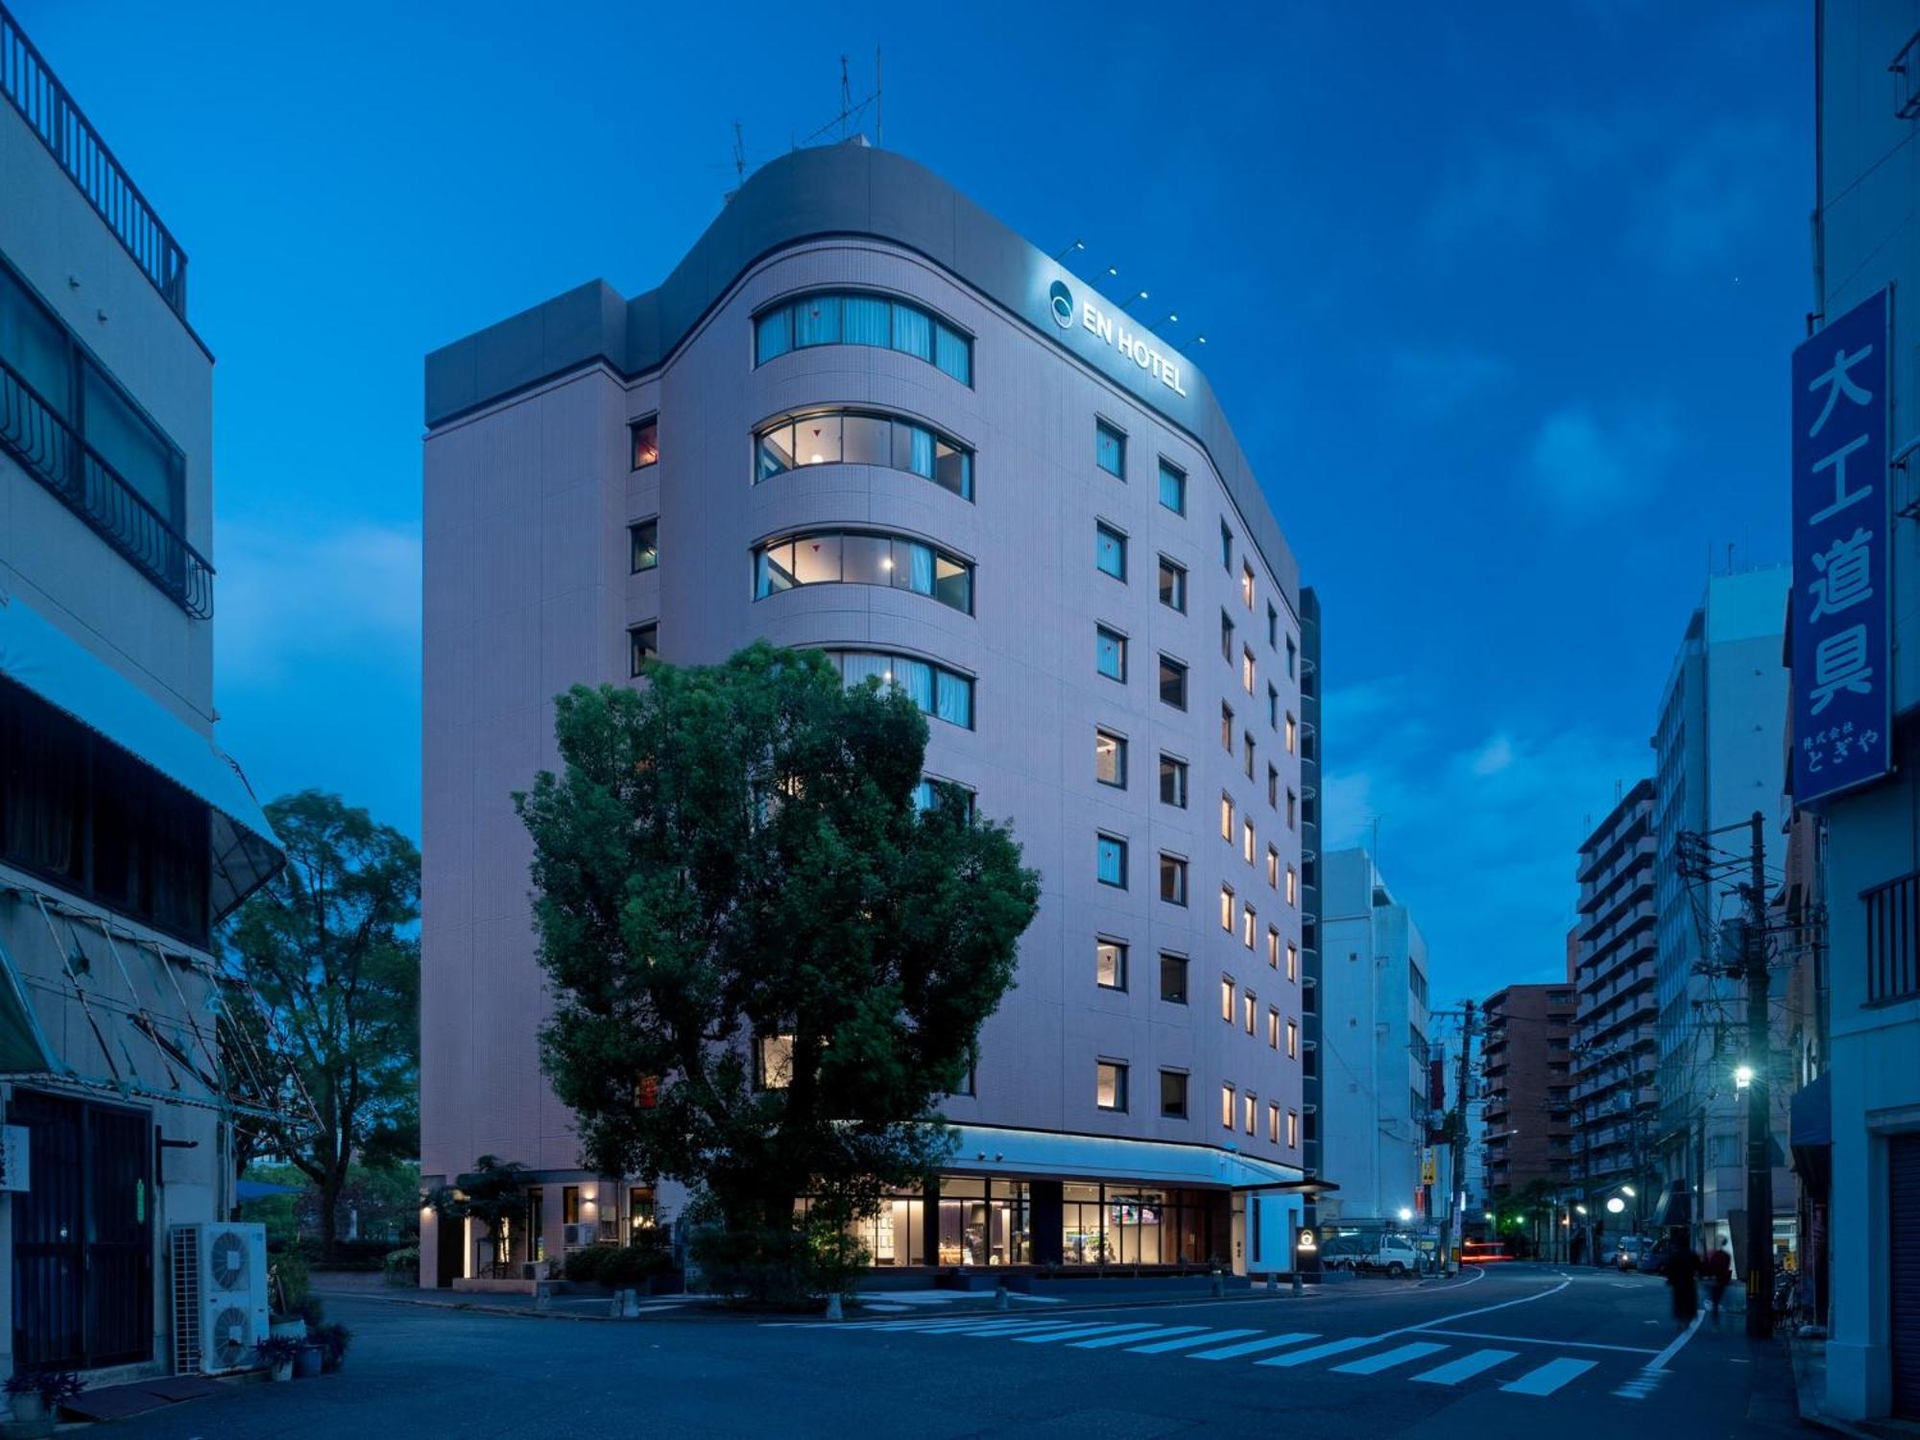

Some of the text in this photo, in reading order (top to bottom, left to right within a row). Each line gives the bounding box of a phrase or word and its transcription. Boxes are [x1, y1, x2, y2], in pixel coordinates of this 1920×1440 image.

[1083, 300, 1186, 397] EN HOTEL
[1808, 344, 1874, 716] 大工道具
[1808, 730, 1878, 772] とぎや
